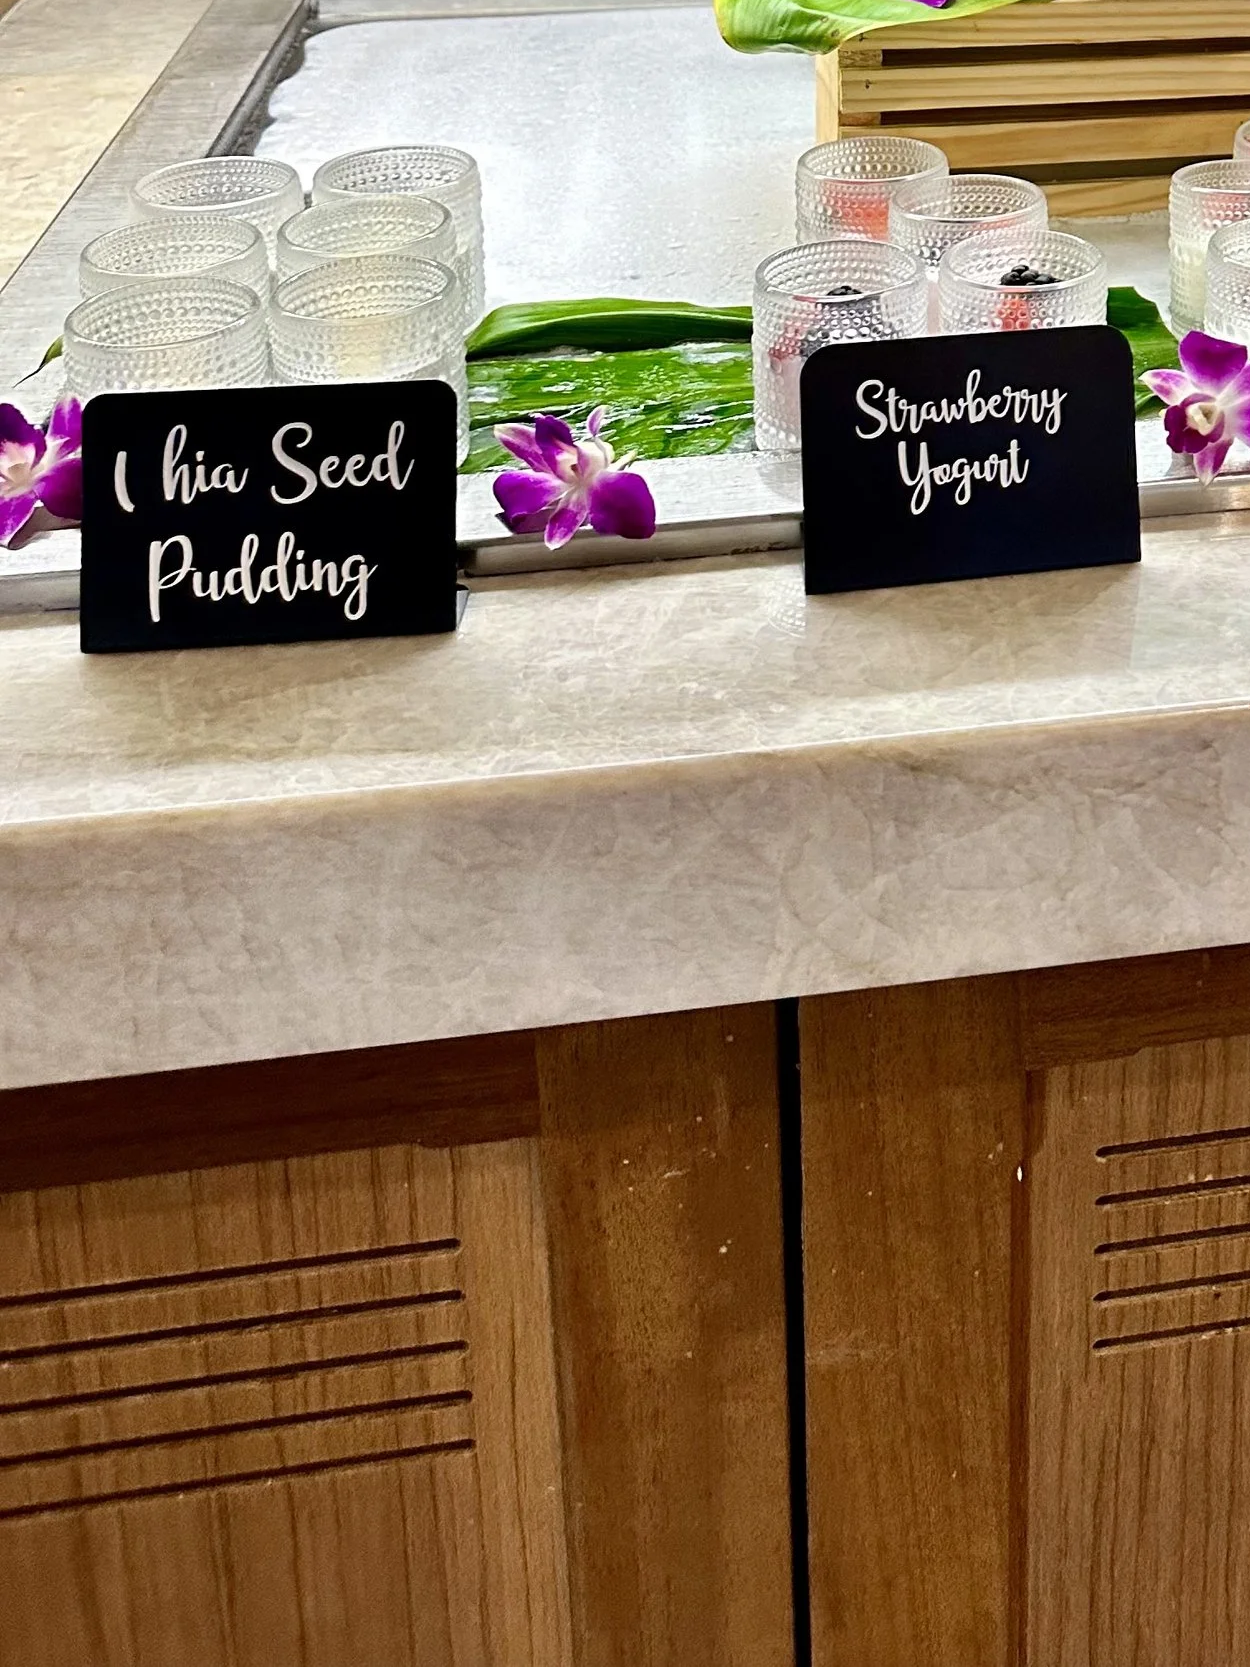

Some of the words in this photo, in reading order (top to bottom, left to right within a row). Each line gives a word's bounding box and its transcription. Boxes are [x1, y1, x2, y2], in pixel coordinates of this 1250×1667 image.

[855, 368, 1068, 440] Strawberry
[270, 420, 415, 505] Seed
[897, 439, 1031, 516] Yogurt
[148, 531, 379, 623] Pudding
